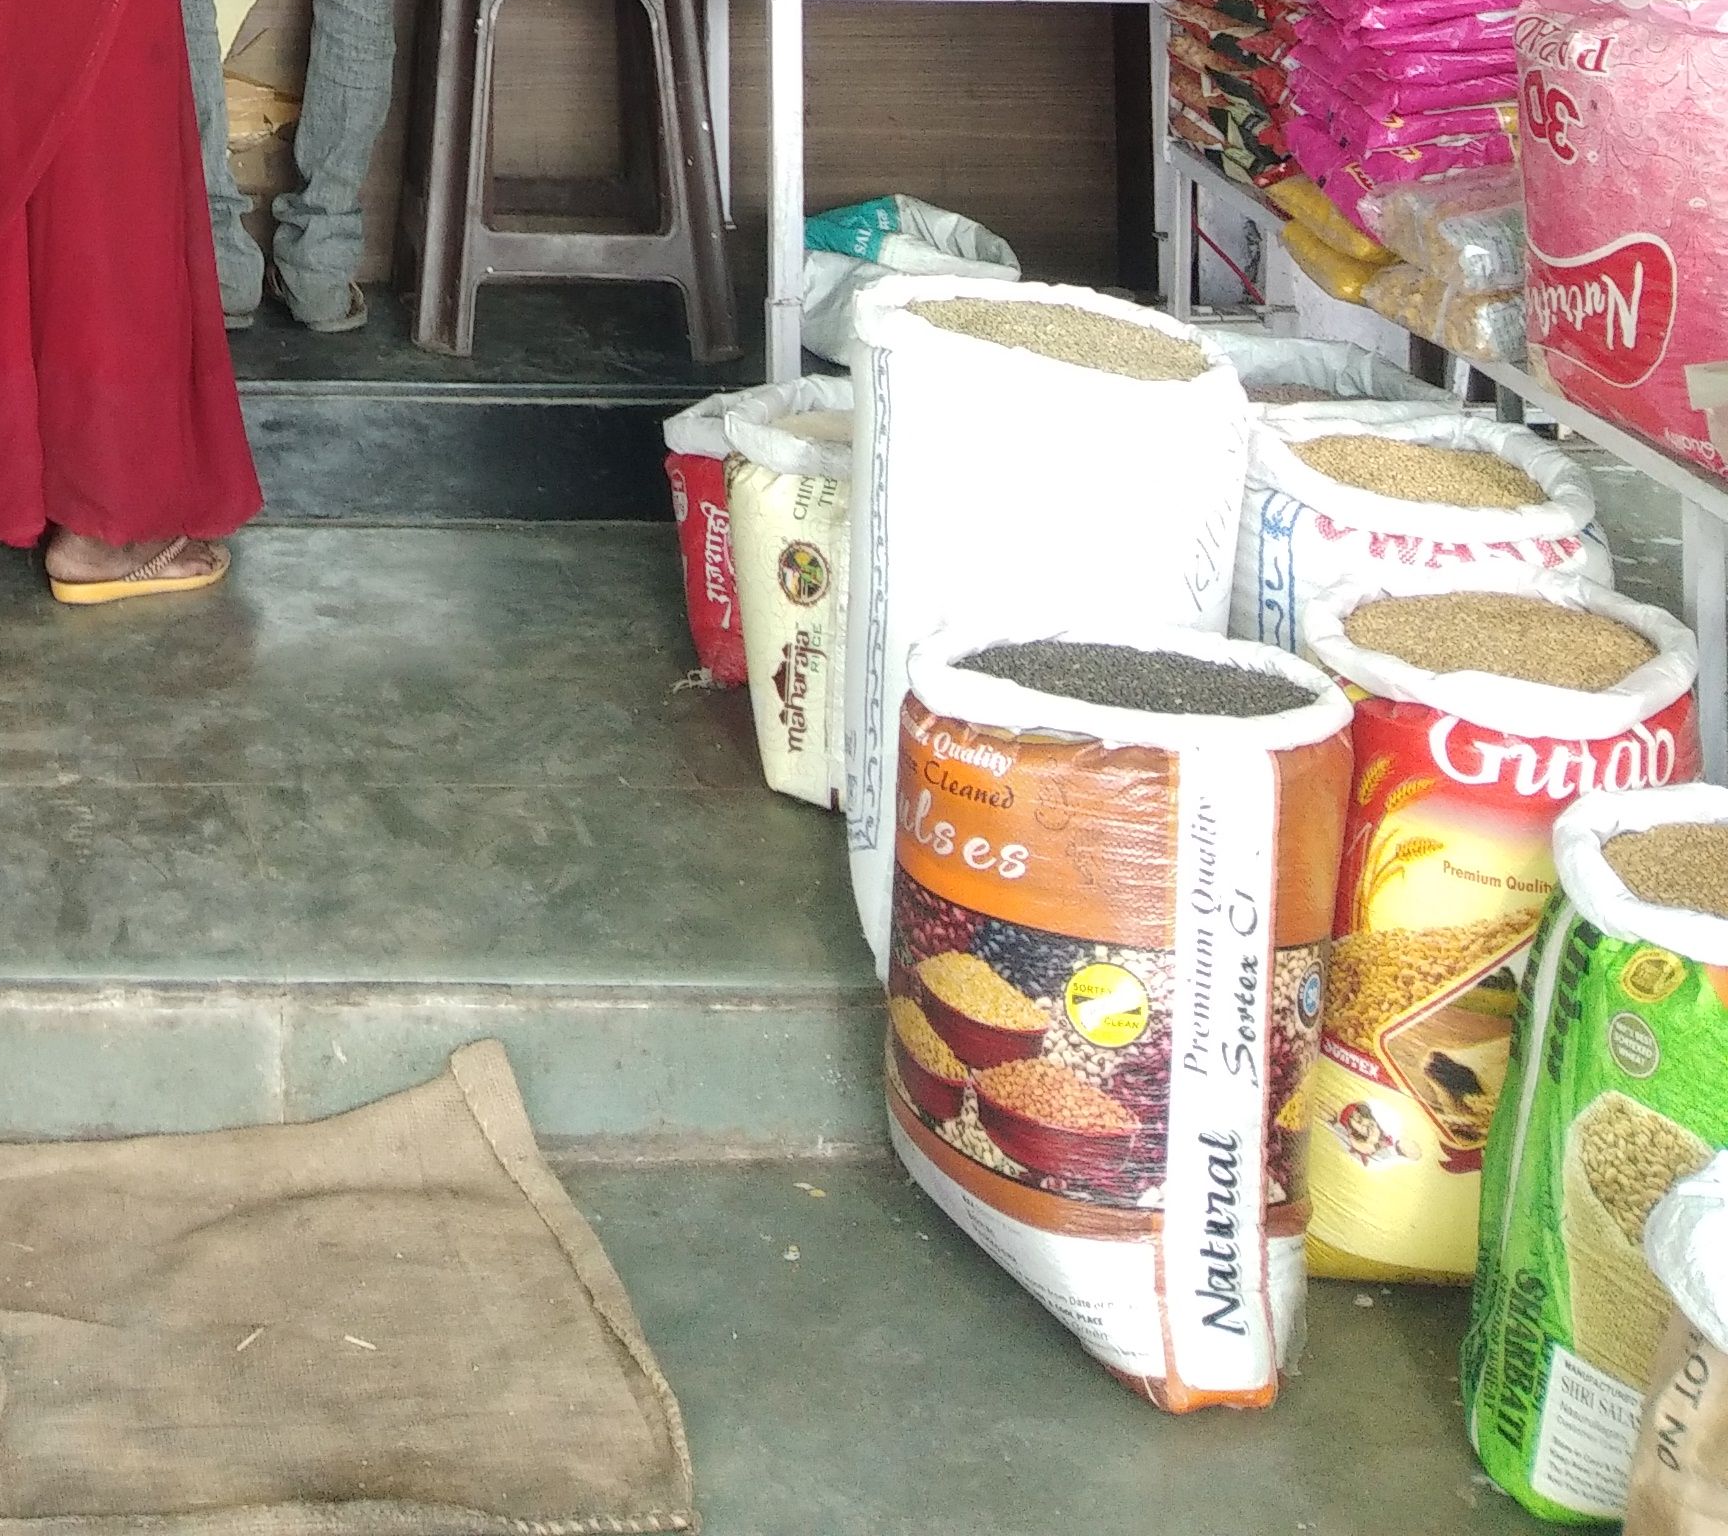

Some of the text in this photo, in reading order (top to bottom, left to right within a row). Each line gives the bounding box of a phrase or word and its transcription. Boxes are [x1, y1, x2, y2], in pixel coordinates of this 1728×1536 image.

[787, 628, 827, 754] maharaja
[810, 623, 822, 674] RICE
[924, 760, 1015, 810] Cleaned
[933, 732, 1014, 777] Quality
[898, 788, 1030, 879] ulses
[1443, 859, 1503, 889] Premium
[1183, 928, 1217, 1078] Premium
[1222, 954, 1260, 1090] Sortex
[1194, 1128, 1249, 1337] Natural
